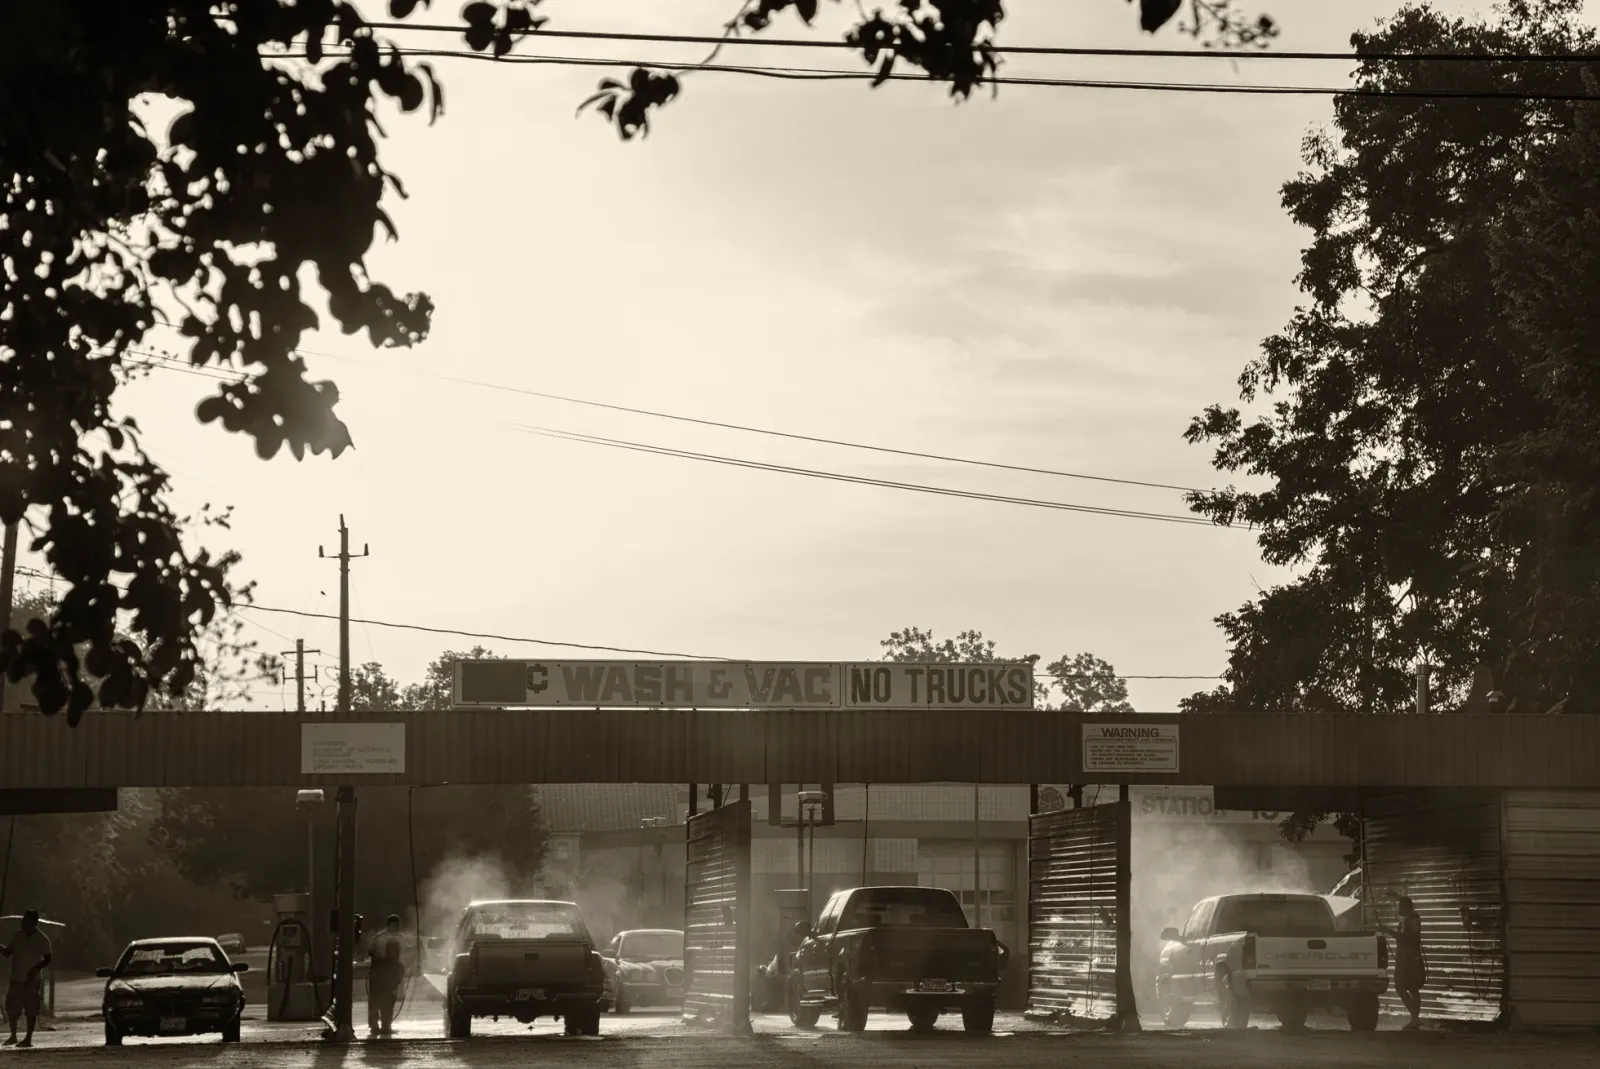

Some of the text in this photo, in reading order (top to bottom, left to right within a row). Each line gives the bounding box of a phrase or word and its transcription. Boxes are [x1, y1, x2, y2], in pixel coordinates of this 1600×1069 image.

[561, 665, 693, 702] WASH
[708, 668, 734, 700] &
[746, 667, 832, 703] VAC
[851, 667, 1027, 705] NO TRUCKS
[1101, 727, 1160, 738] WARNING
[1140, 794, 1228, 817] STATIO
